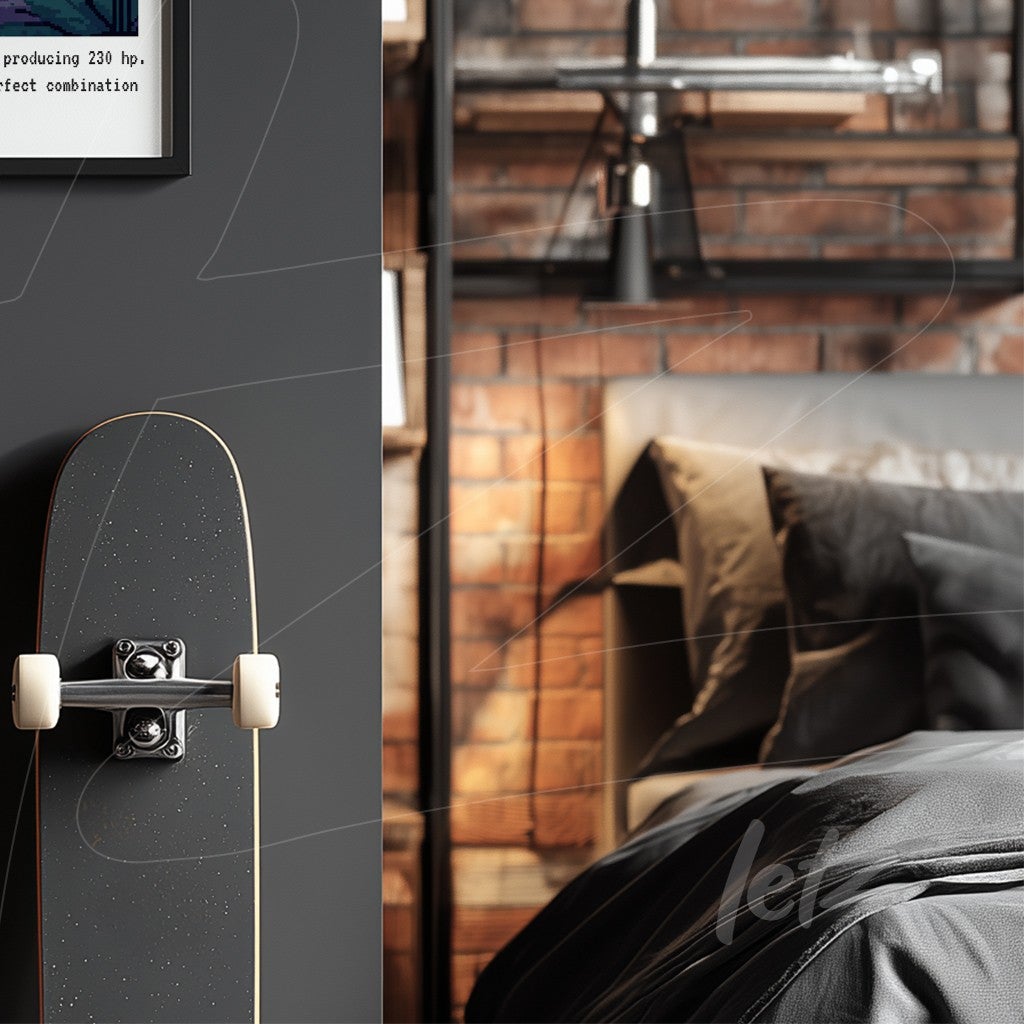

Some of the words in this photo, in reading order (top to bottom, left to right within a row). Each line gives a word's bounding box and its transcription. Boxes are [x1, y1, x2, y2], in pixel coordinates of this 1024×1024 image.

[3, 50, 80, 68] producing
[88, 50, 113, 65] 230
[121, 50, 145, 68] hp.
[45, 78, 139, 92] combination
